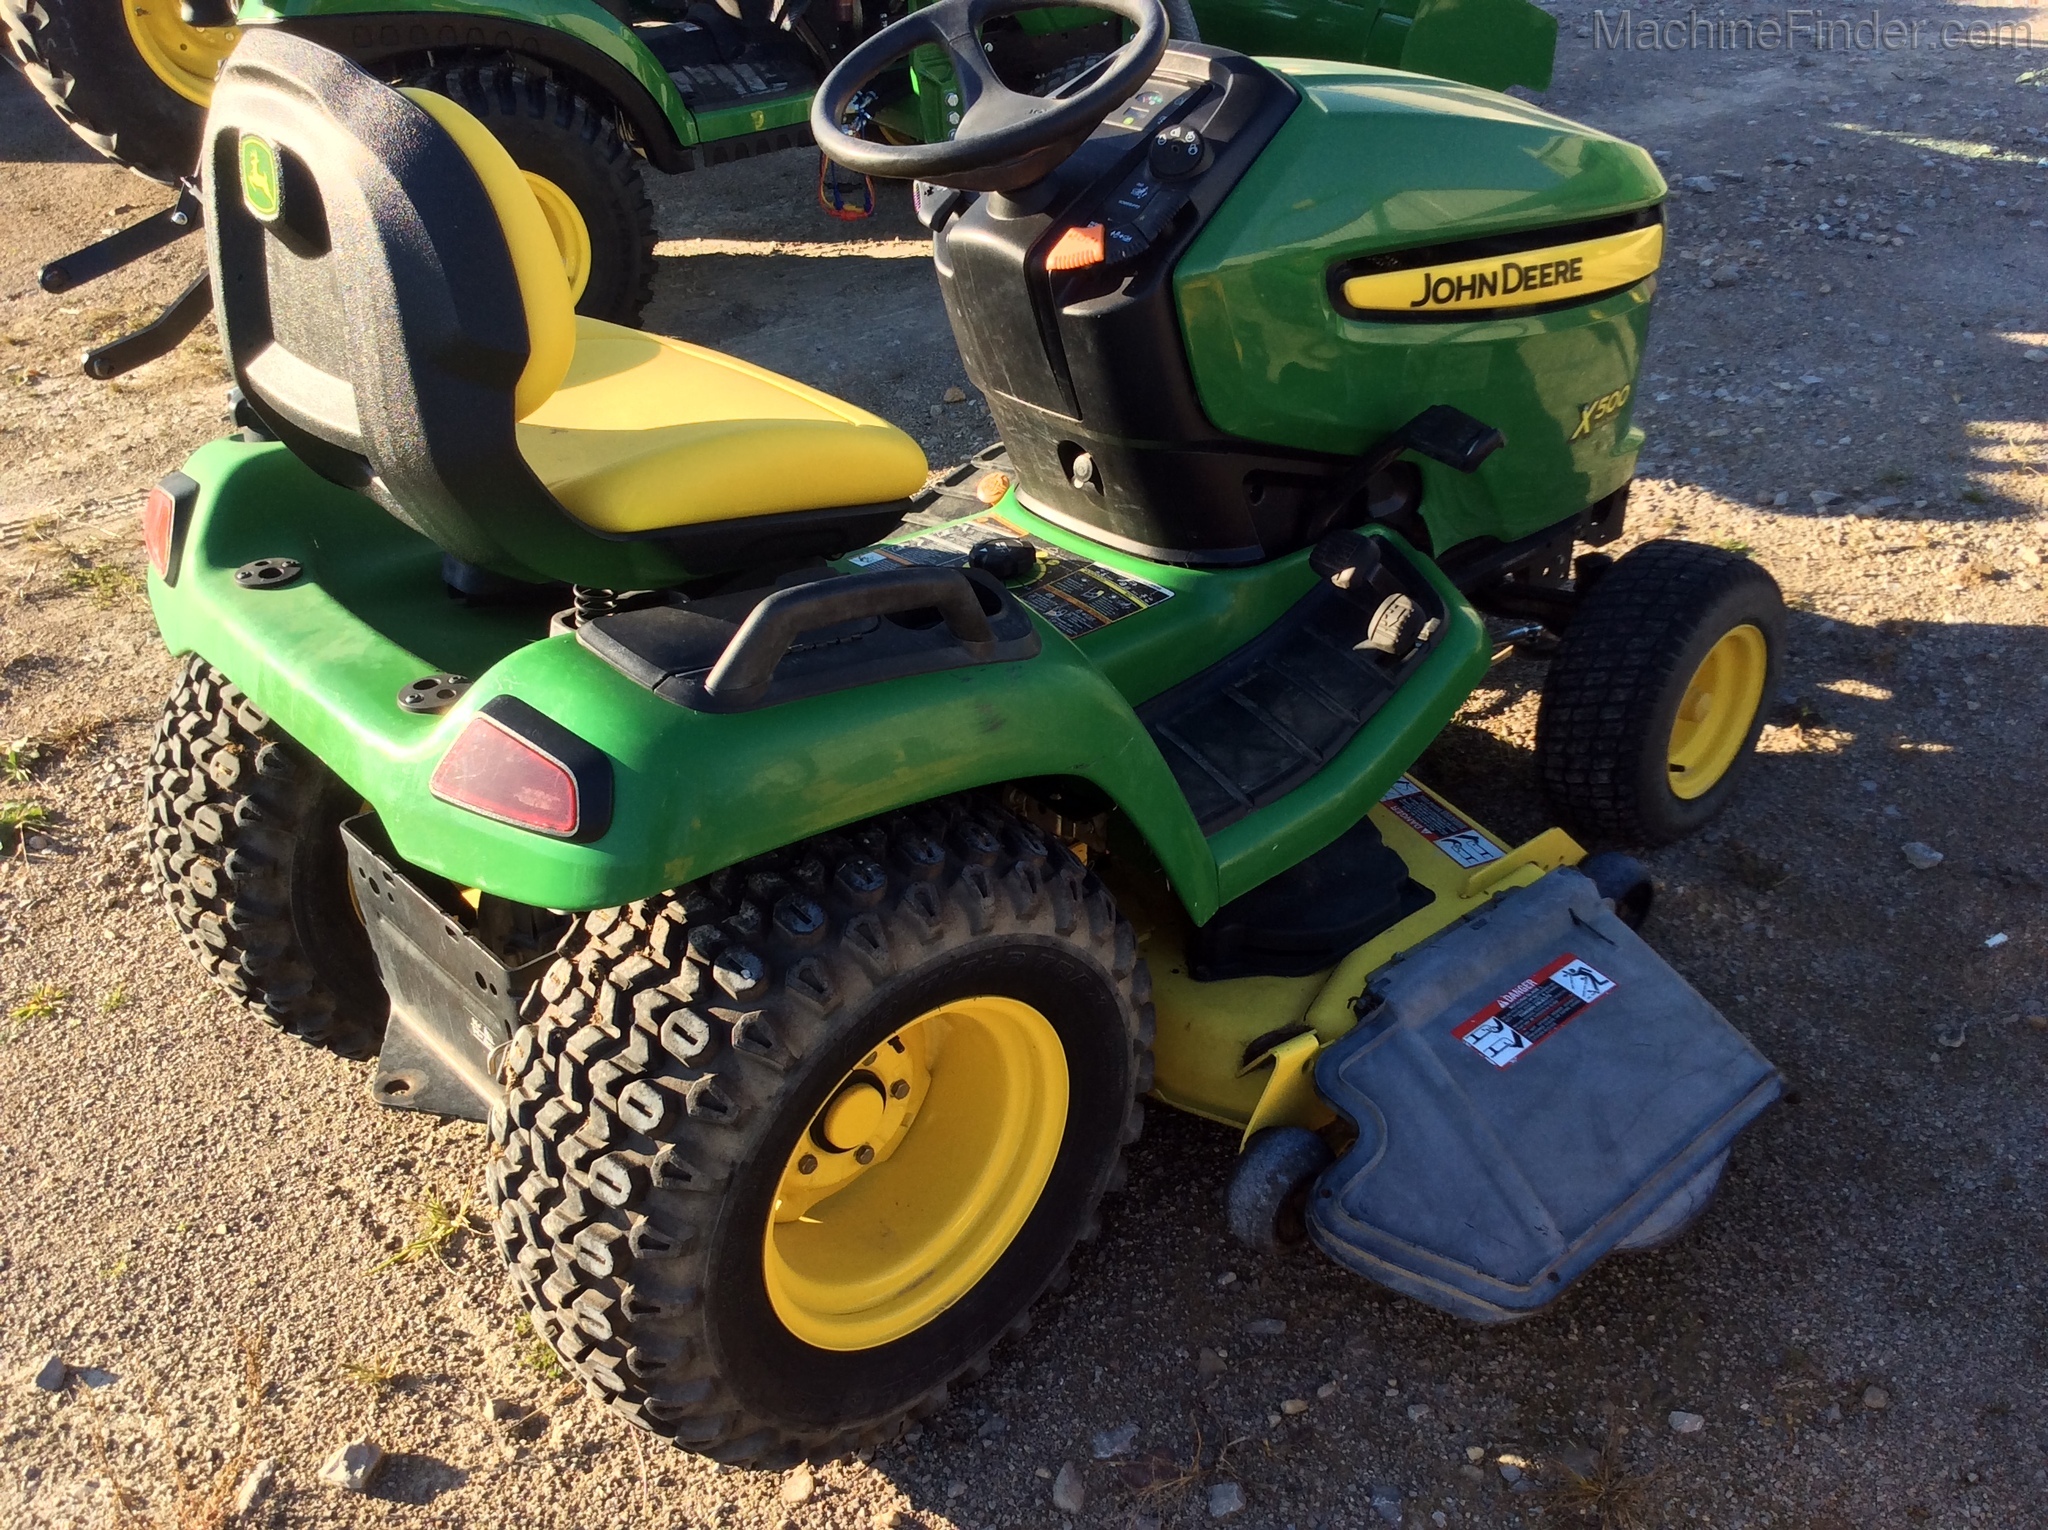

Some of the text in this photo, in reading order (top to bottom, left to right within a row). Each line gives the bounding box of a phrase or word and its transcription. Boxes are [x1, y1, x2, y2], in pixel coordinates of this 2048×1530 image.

[1410, 257, 1583, 308] JOHN DEERE
[1568, 383, 1631, 444] X500
[1389, 805, 1423, 831] DANGER
[1503, 978, 1539, 1004] DANGER
